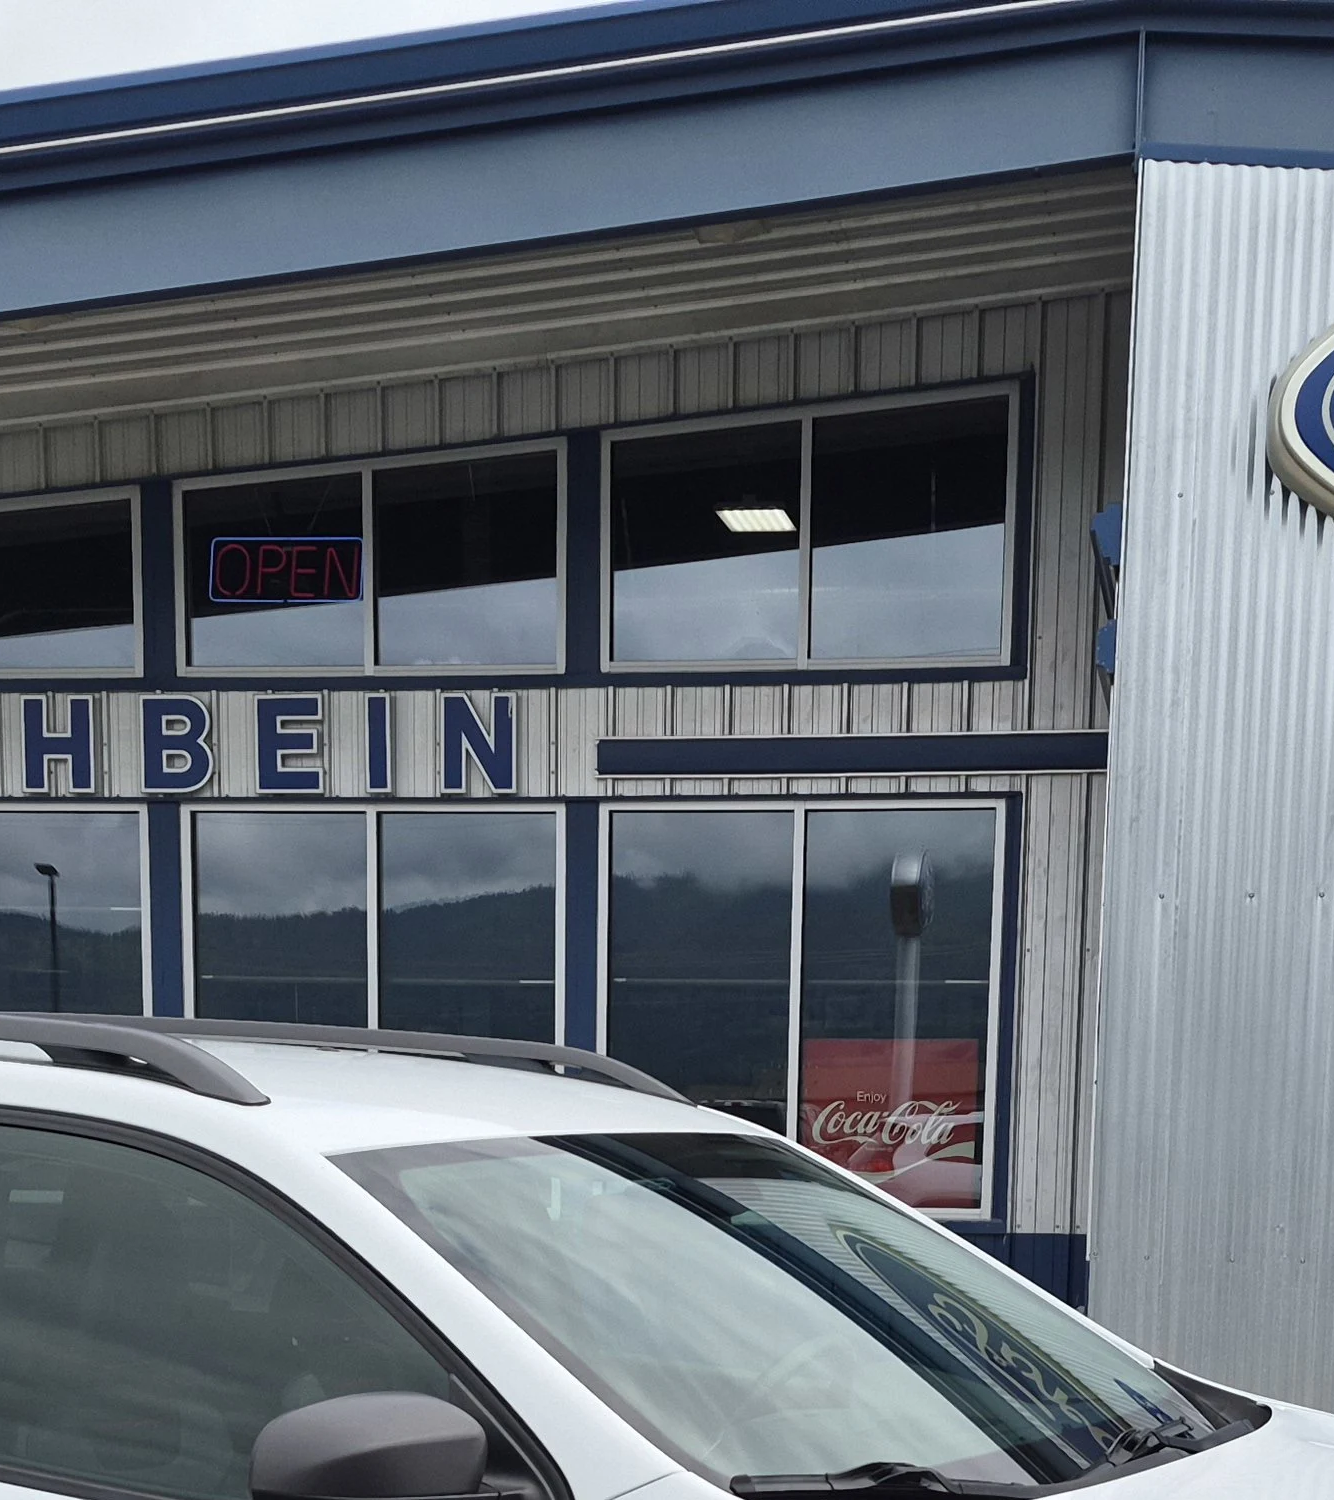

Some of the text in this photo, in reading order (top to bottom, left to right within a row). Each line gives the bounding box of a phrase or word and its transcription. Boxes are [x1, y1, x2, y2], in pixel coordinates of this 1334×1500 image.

[217, 543, 360, 598] OPEN
[856, 1090, 887, 1102] Enjoy
[812, 1100, 962, 1145] Coca-Cola
